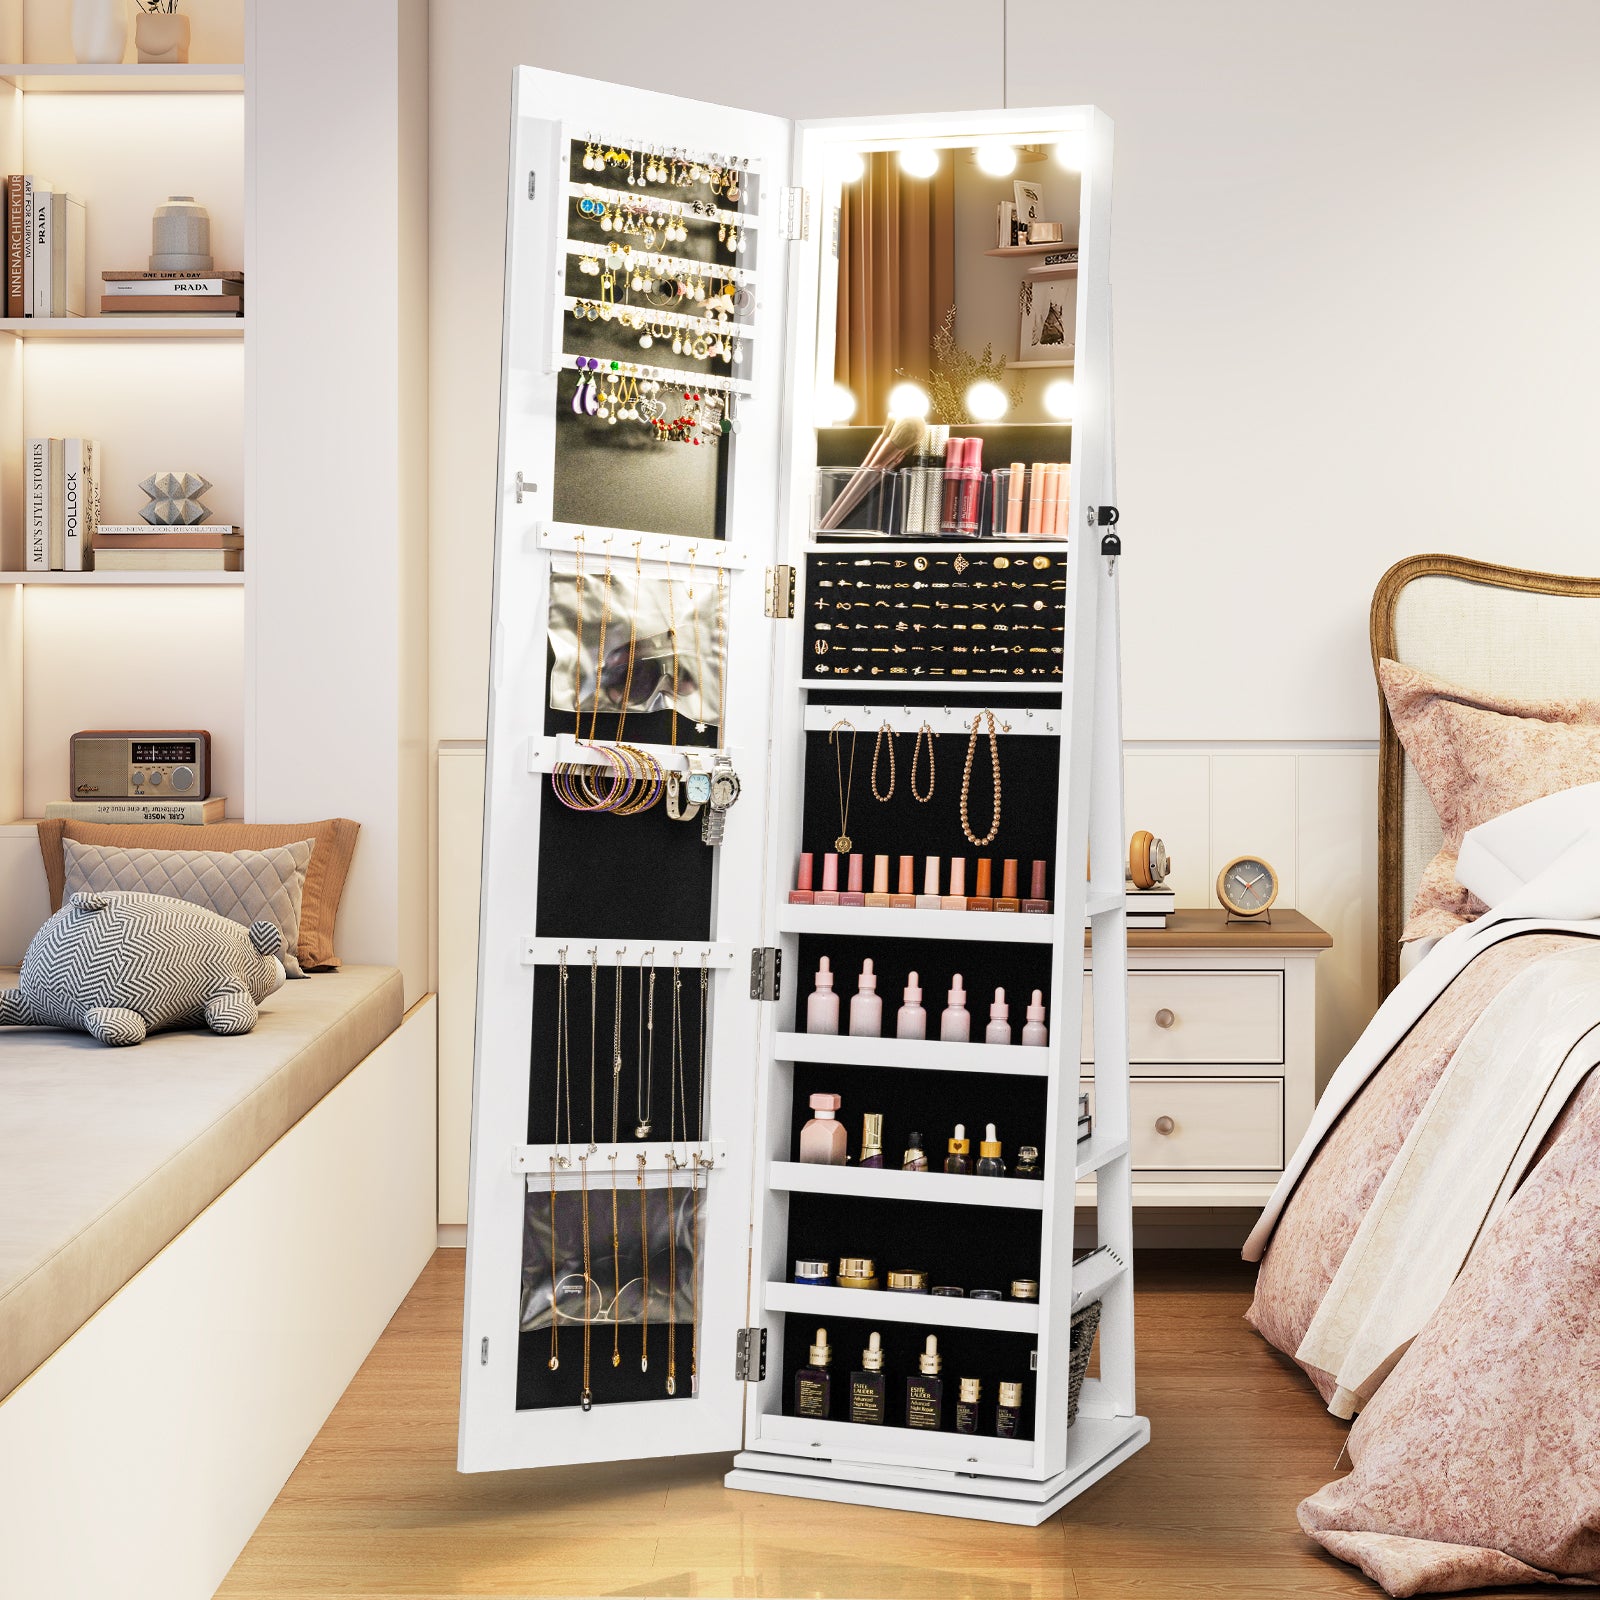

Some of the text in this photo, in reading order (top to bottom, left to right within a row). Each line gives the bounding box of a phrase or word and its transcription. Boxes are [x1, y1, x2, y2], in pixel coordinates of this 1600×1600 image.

[11, 175, 22, 298] INNENARCHITEKTUR
[38, 206, 46, 245] PRADA
[174, 284, 209, 292] PRADA
[33, 443, 43, 563] MEN'S STYLE STORIES
[67, 472, 77, 537] POLLOCK
